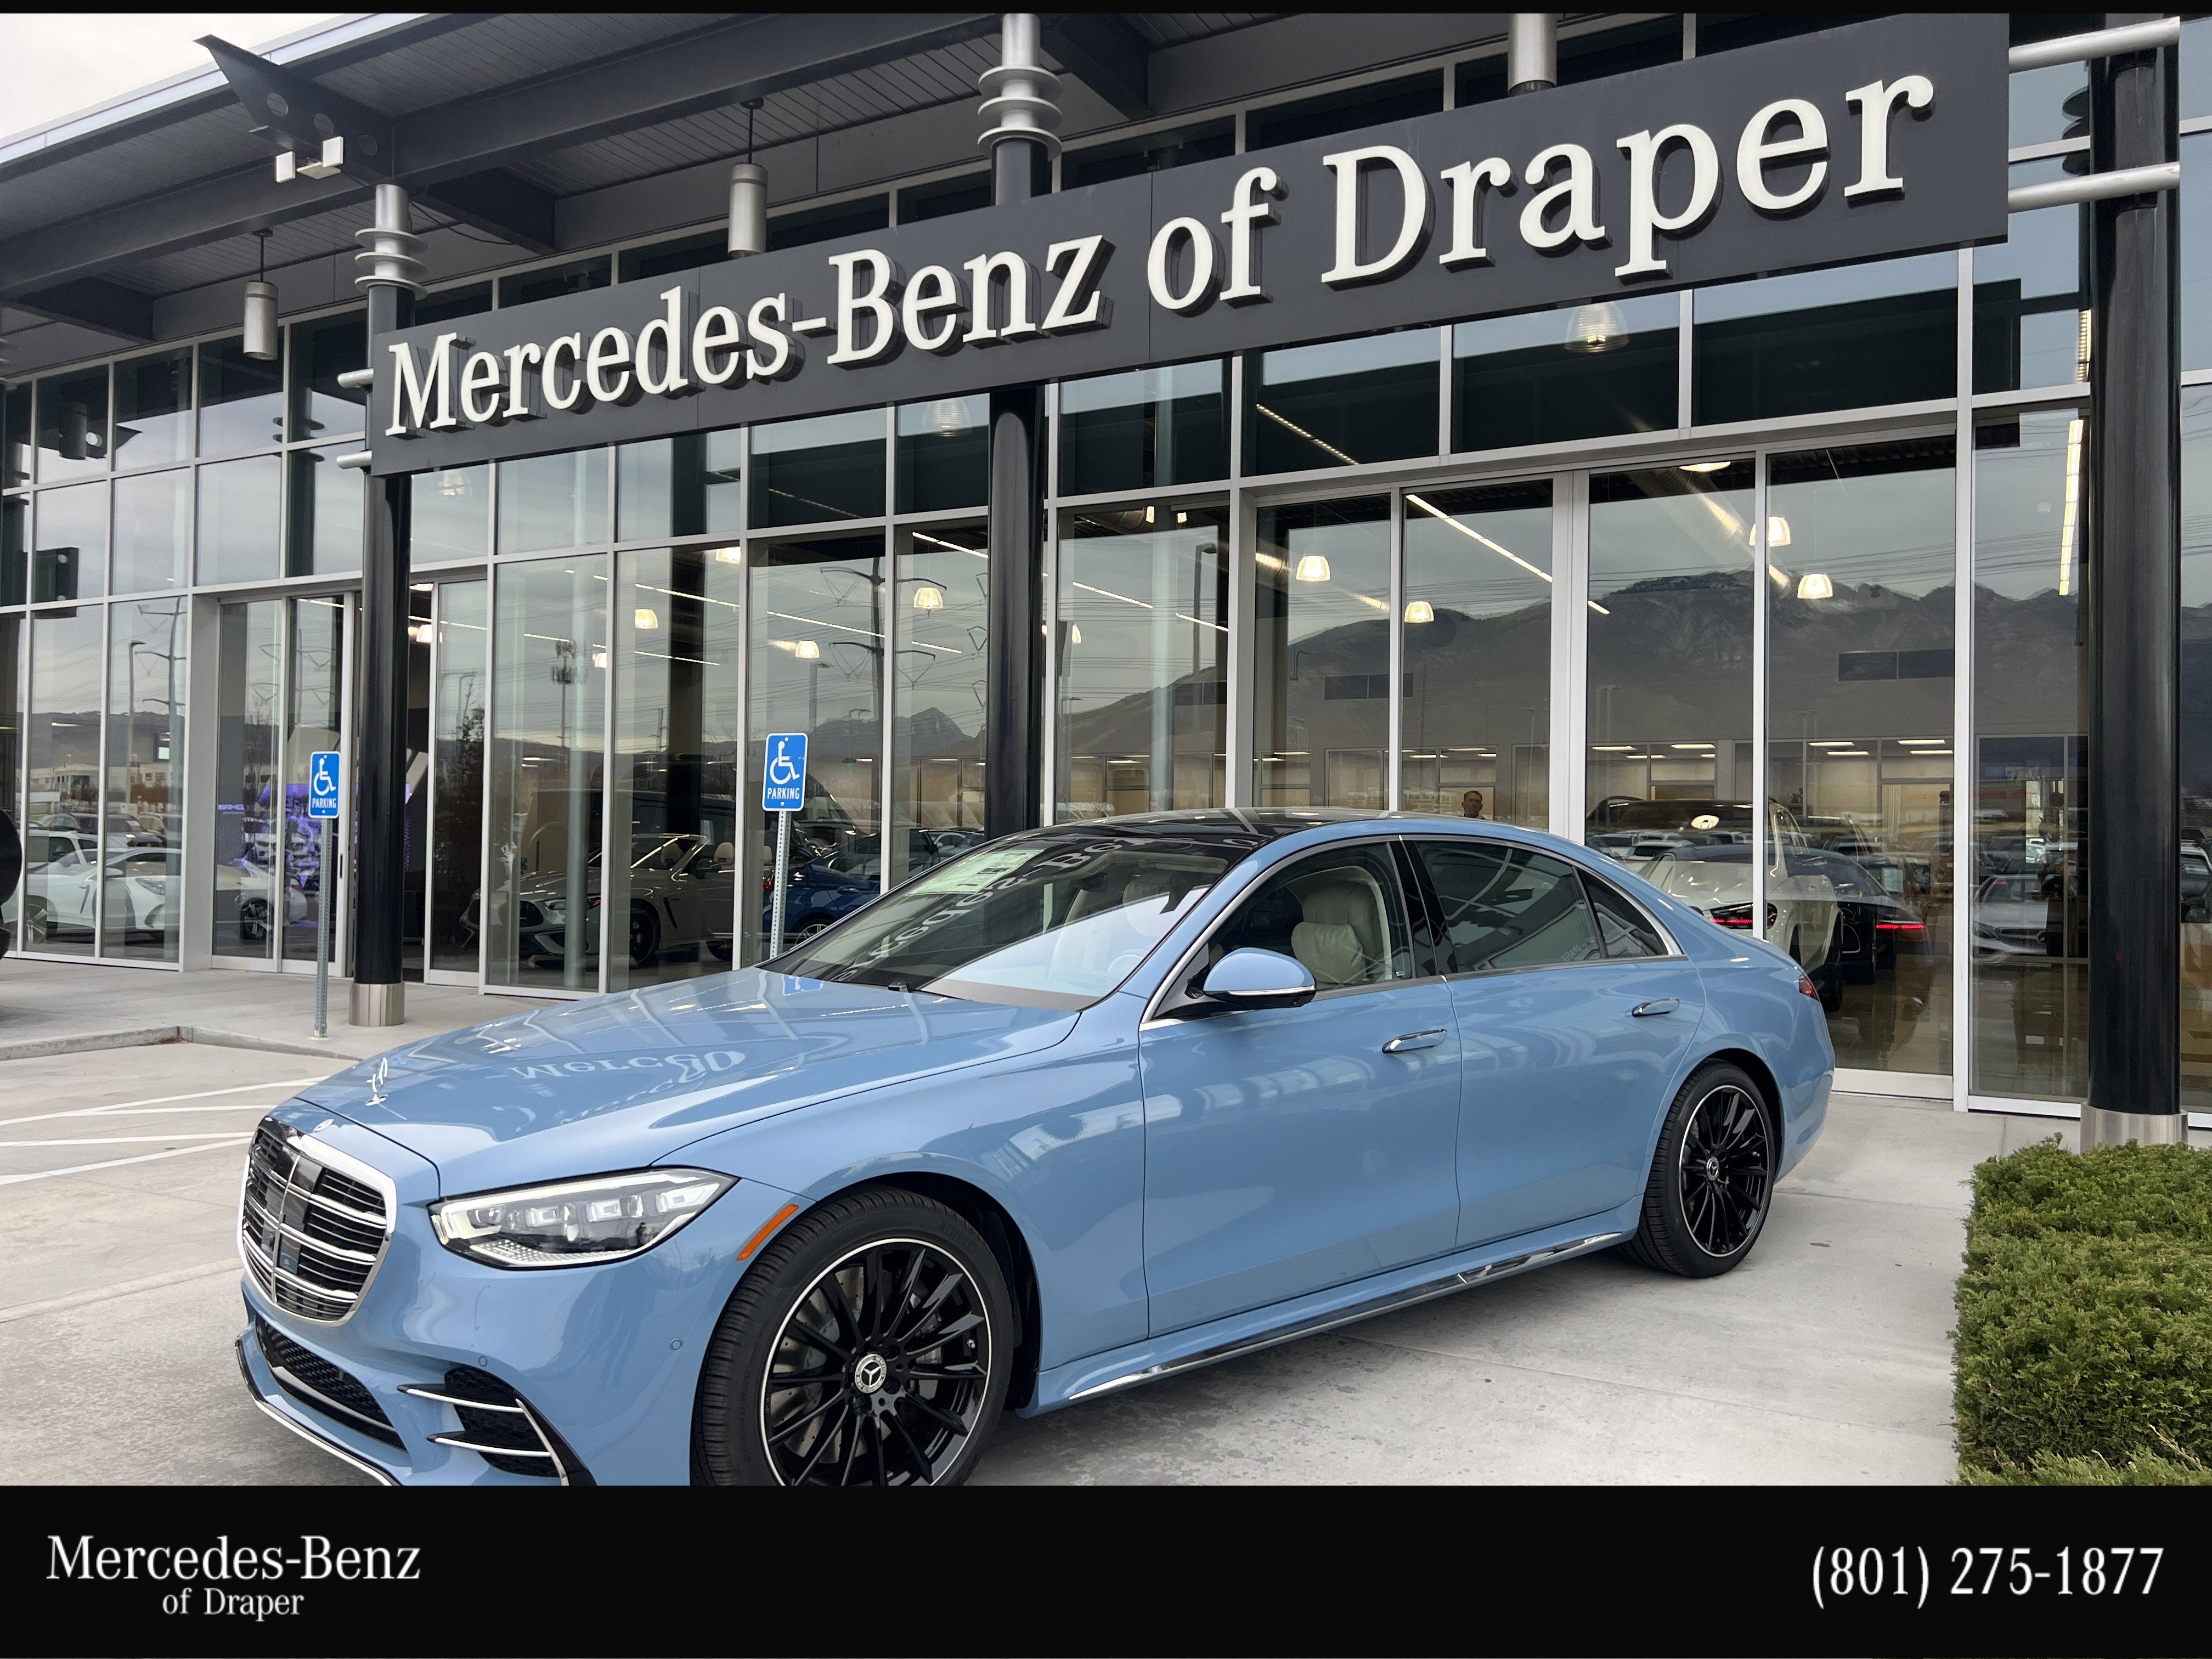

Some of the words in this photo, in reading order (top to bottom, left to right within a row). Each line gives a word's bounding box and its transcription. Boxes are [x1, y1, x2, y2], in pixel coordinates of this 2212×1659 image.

[385, 234, 1103, 437] Mercedes-Benz
[1147, 167, 1277, 310] of
[1321, 75, 1934, 283] Draper
[766, 787, 800, 800] PARKING
[311, 797, 337, 809] PARKING
